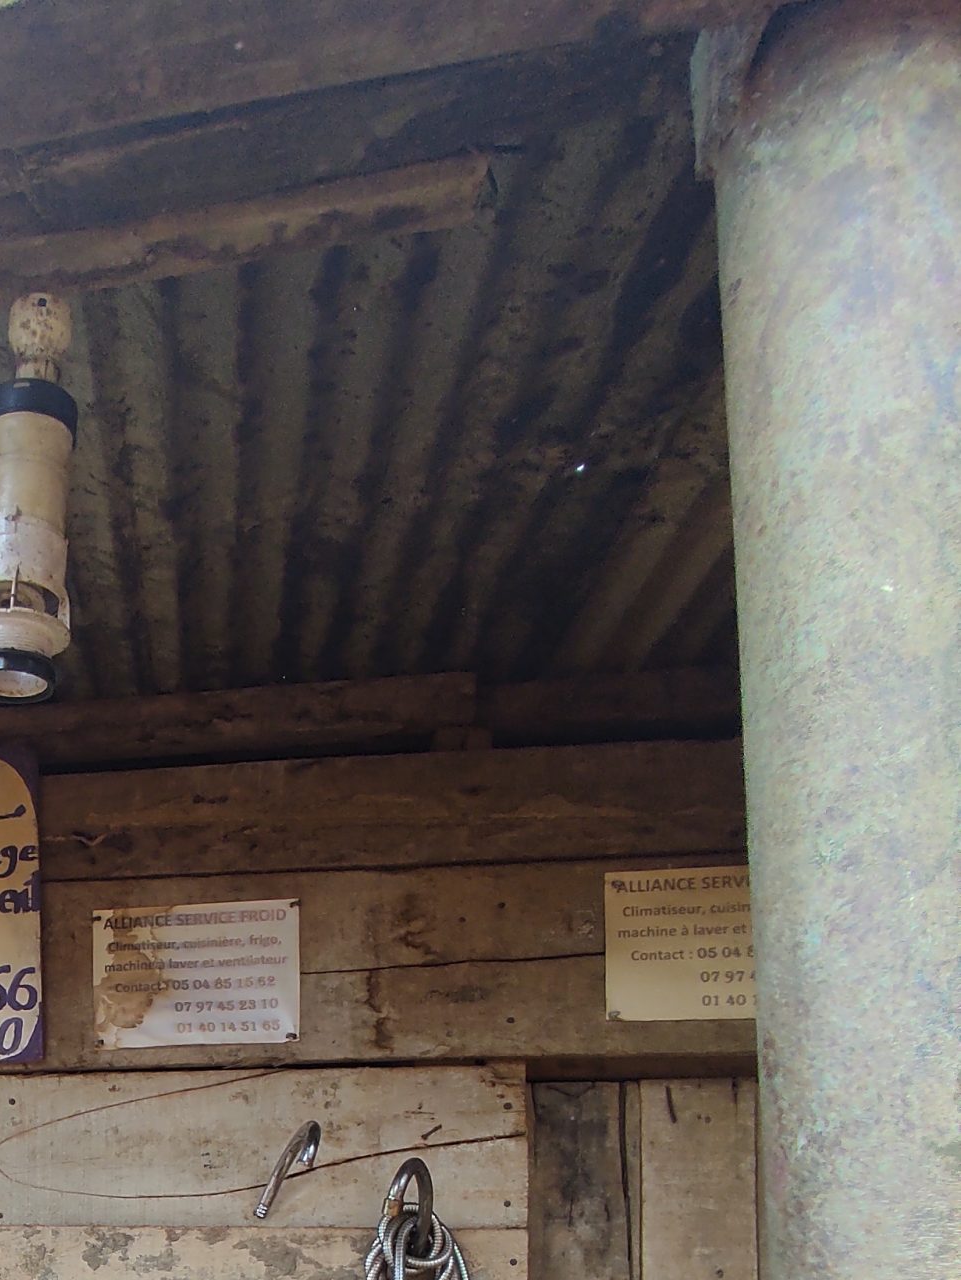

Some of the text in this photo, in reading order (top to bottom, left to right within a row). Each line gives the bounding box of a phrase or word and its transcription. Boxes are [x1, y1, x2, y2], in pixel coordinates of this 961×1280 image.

[103, 908, 287, 930] ALLIANCE SERVICE FROID
[618, 922, 747, 938] machine à laver et
[631, 949, 685, 961] Contact
[697, 946, 718, 959] 05
[169, 957, 199, 969] laver
[203, 957, 215, 968] et
[700, 970, 720, 983] 07
[725, 970, 745, 983] 97
[175, 1001, 191, 1012] 07
[196, 1001, 213, 1013] 97
